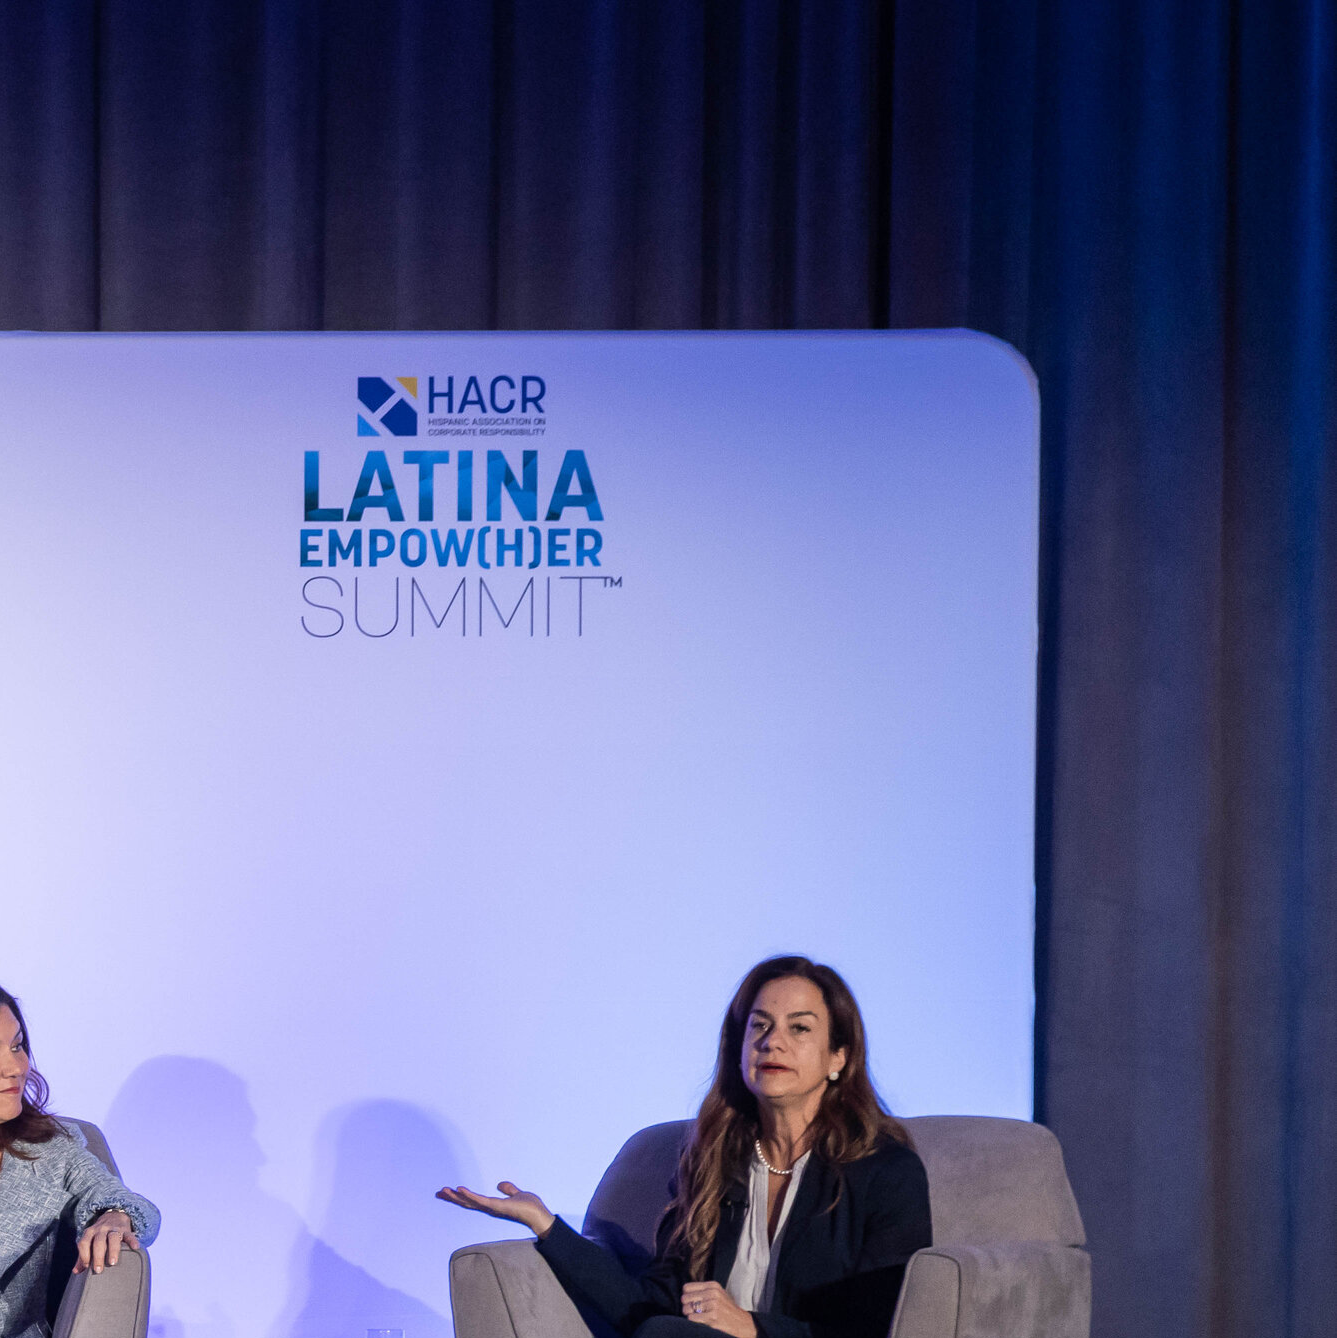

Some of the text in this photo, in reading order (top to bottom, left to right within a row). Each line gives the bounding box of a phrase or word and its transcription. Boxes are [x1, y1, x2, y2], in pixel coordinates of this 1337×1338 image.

[428, 375, 547, 414] HACR
[304, 450, 604, 522] LATINA
[299, 526, 603, 569] EMPOW(H)ER
